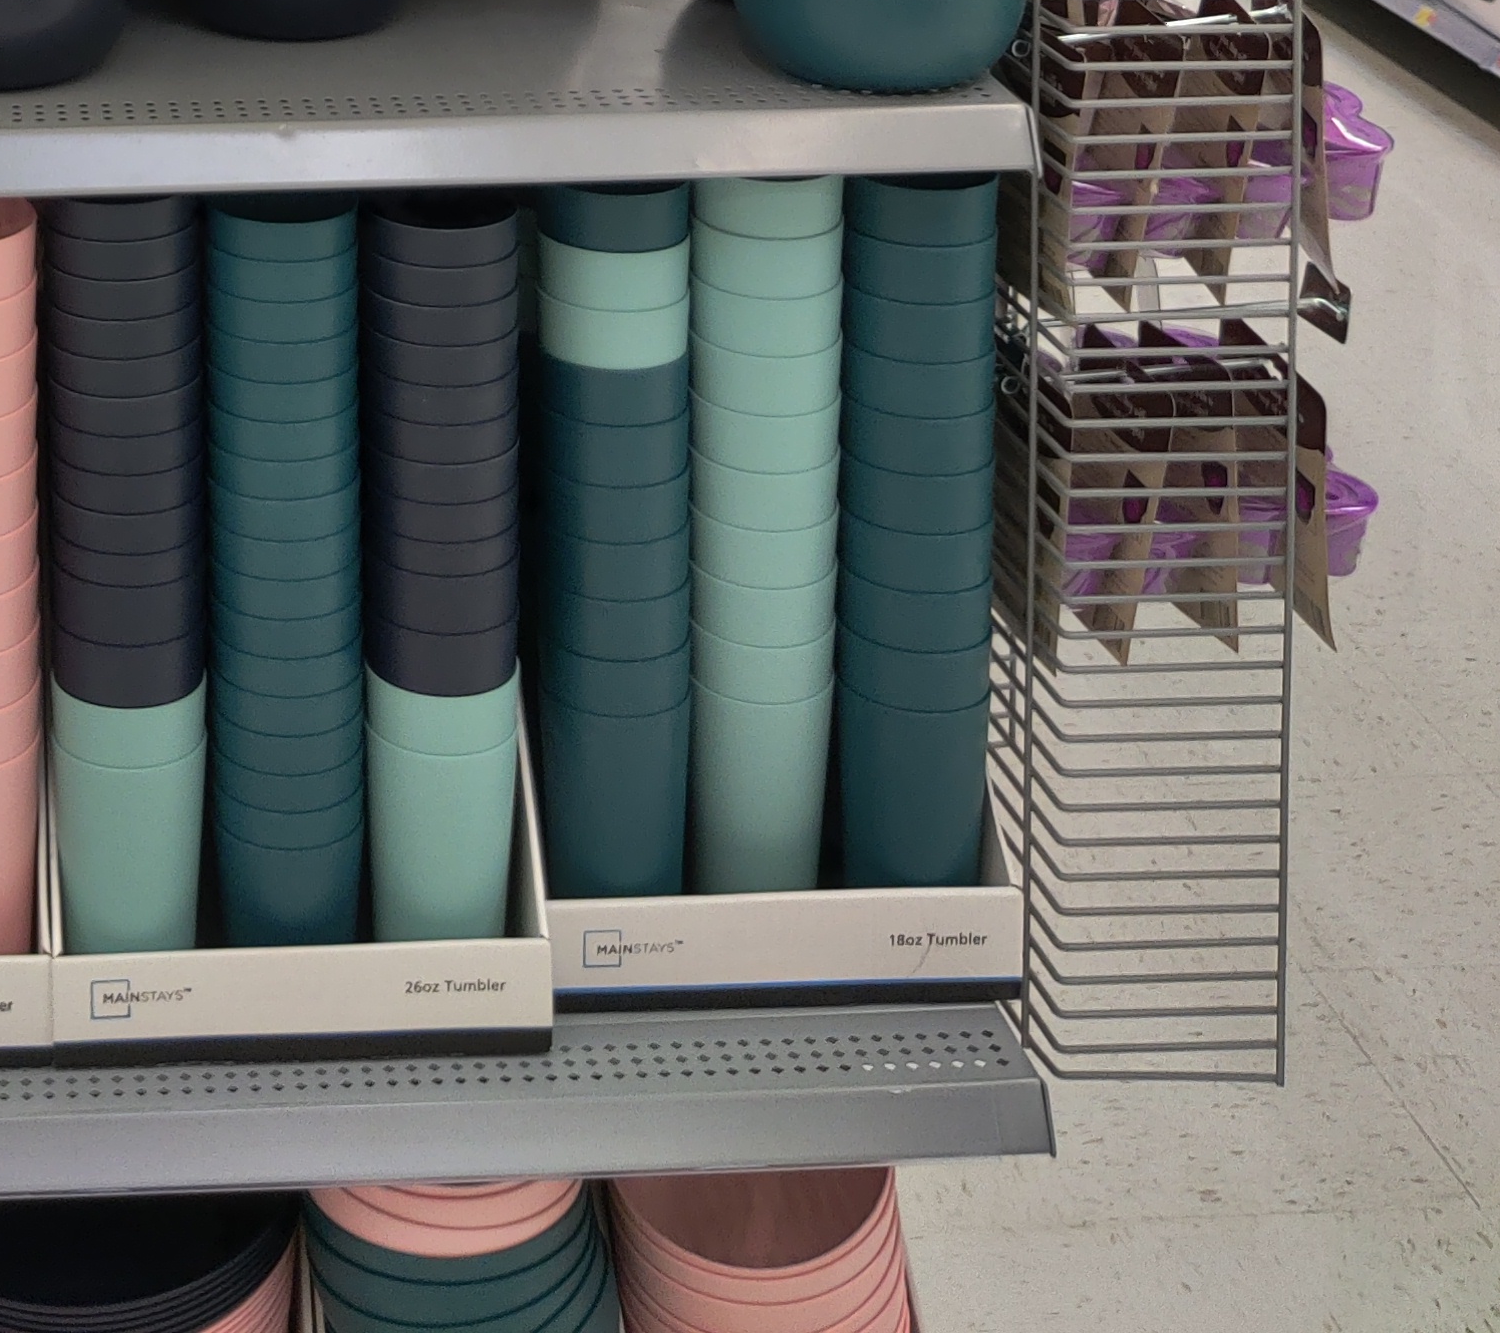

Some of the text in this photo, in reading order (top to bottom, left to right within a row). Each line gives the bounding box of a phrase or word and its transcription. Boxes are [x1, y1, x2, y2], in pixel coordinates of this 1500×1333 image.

[889, 931, 988, 948] 18oz Tumbler
[405, 978, 507, 995] 26oz Tumbler
